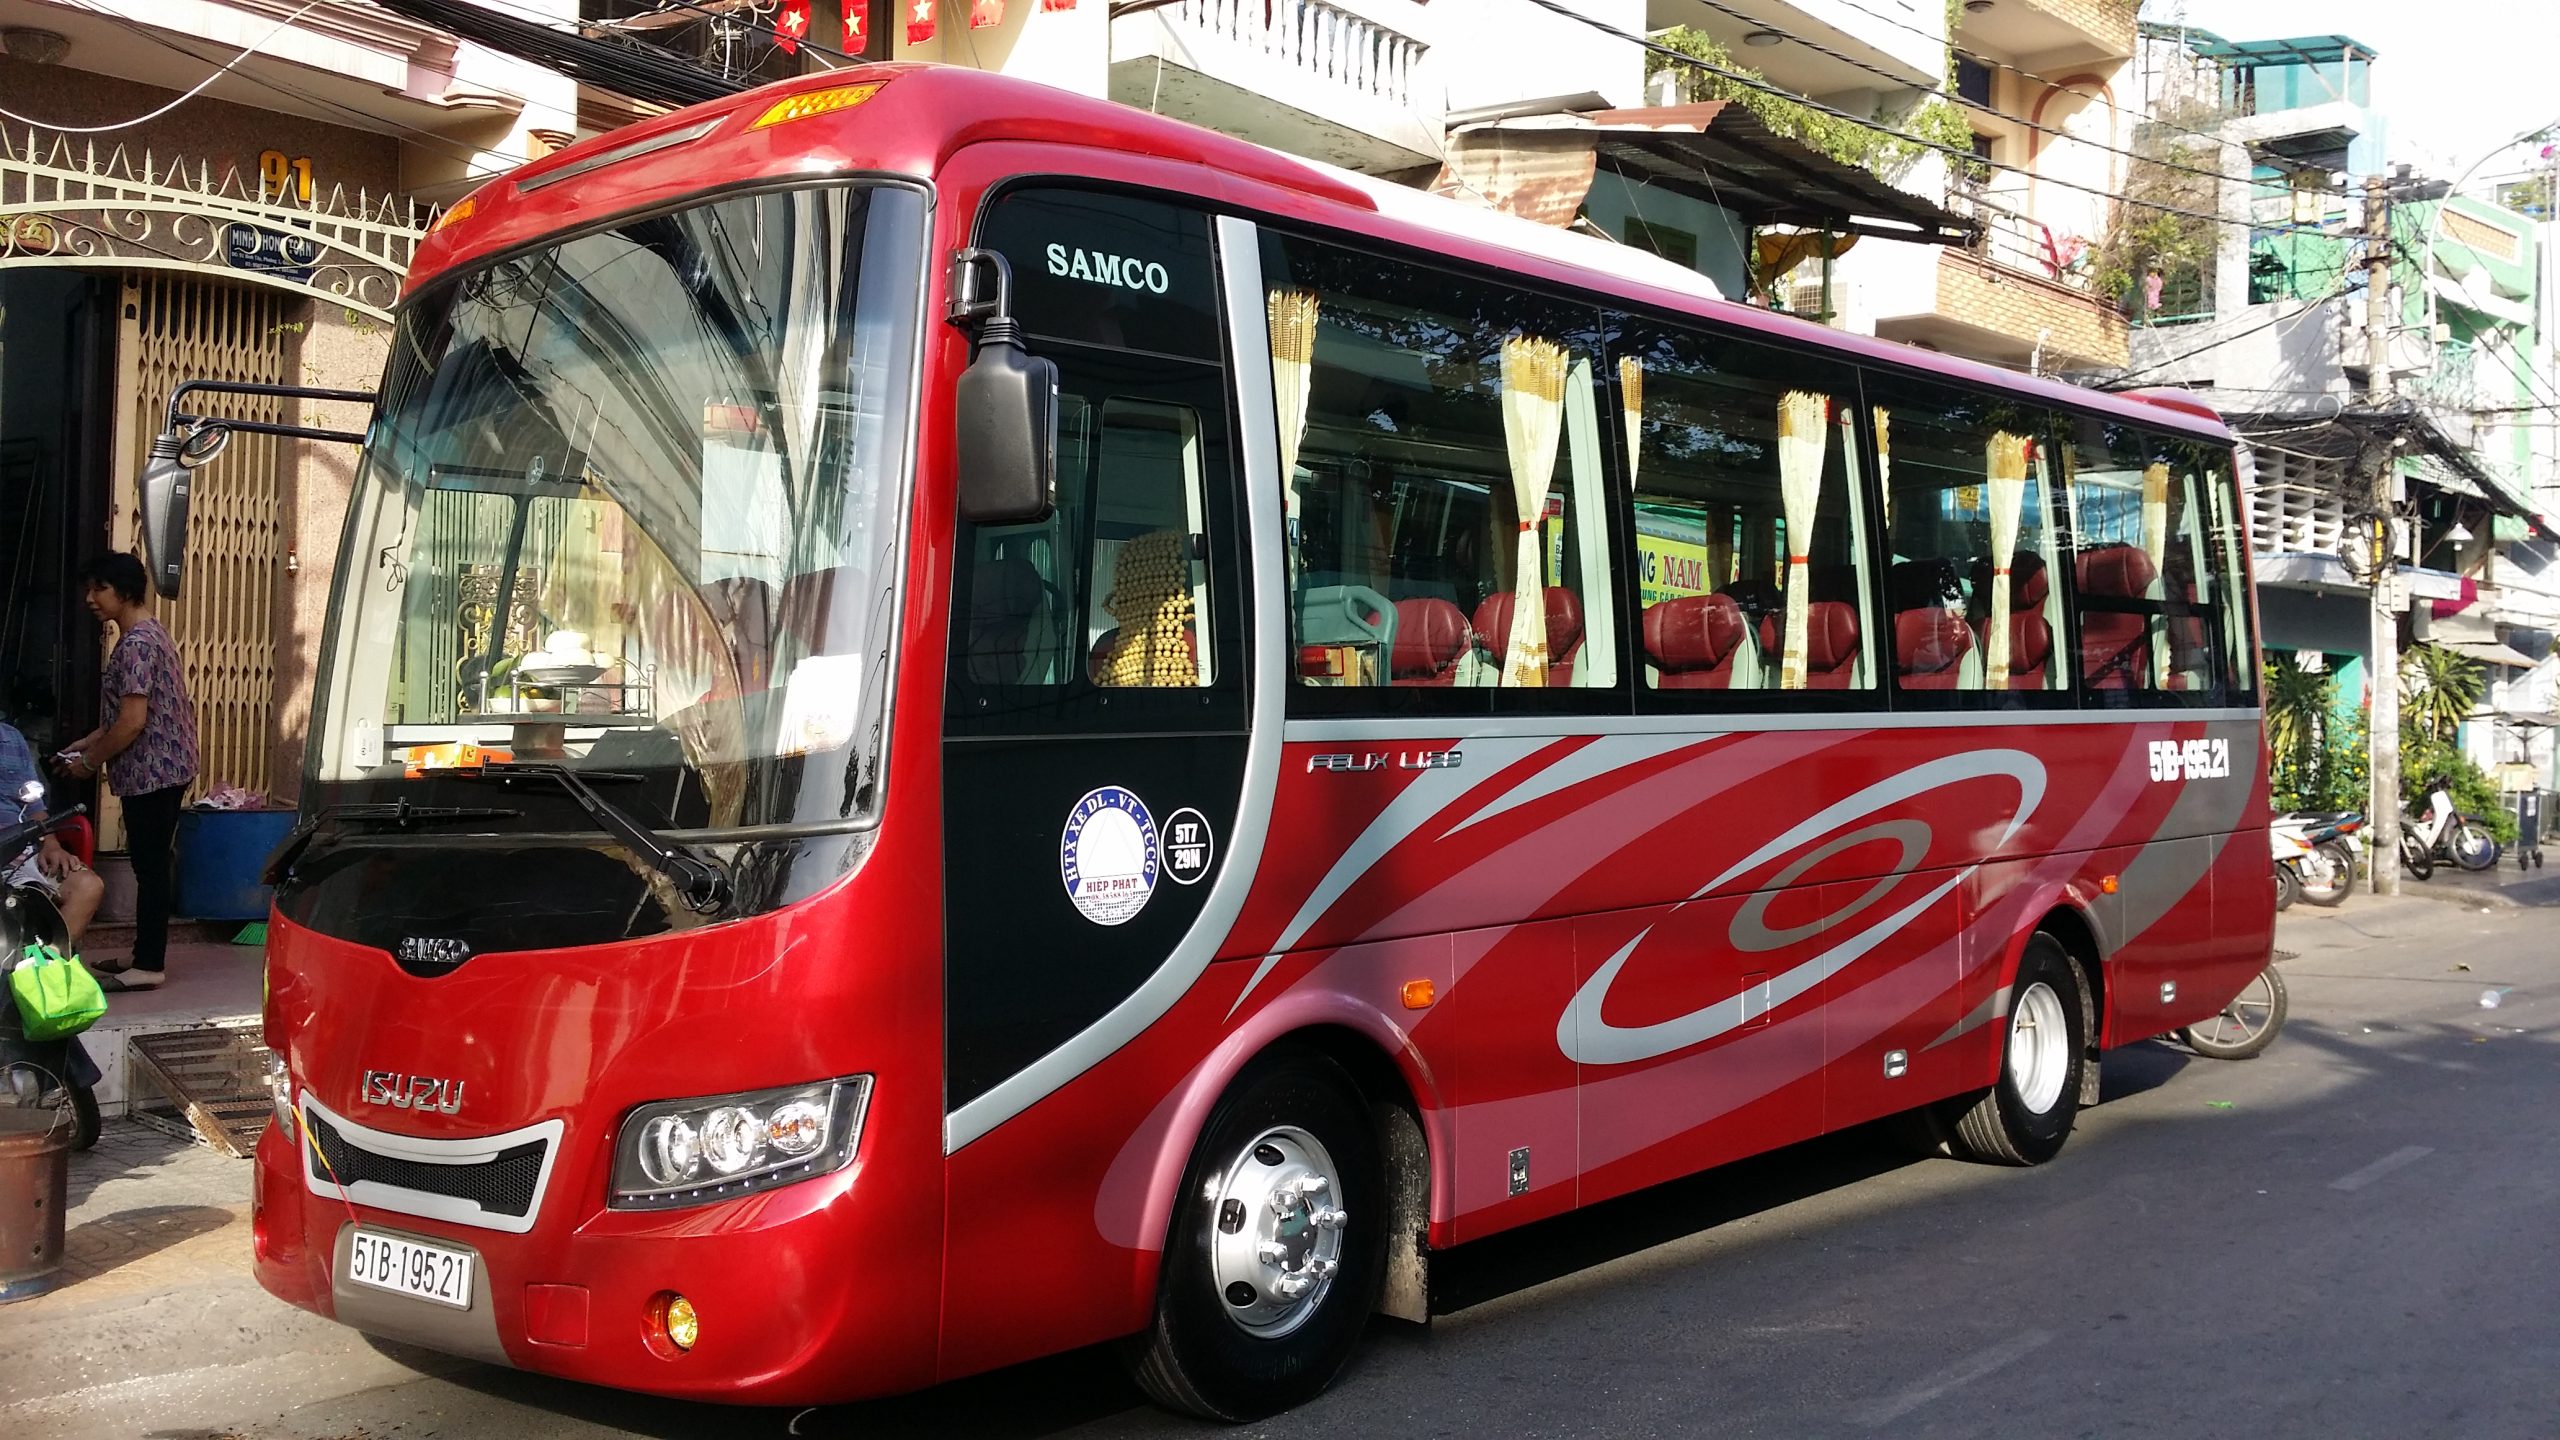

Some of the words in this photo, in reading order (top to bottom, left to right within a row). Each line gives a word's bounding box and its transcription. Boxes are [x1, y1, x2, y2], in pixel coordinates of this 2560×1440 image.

[260, 150, 311, 201] 91
[232, 229, 255, 249] MINH
[263, 234, 285, 253] HON
[1046, 243, 1169, 293] SAMCO
[1663, 555, 1703, 591] NAM
[1306, 752, 1390, 773] FELIX
[1086, 793, 1107, 813] DL
[1118, 793, 1137, 813] VT
[1069, 809, 1088, 837] XE
[1175, 823, 1198, 844] 5T7
[1065, 839, 1080, 881] HTX
[1174, 848, 1200, 869] 29N
[362, 1070, 464, 1114] ISUZU
